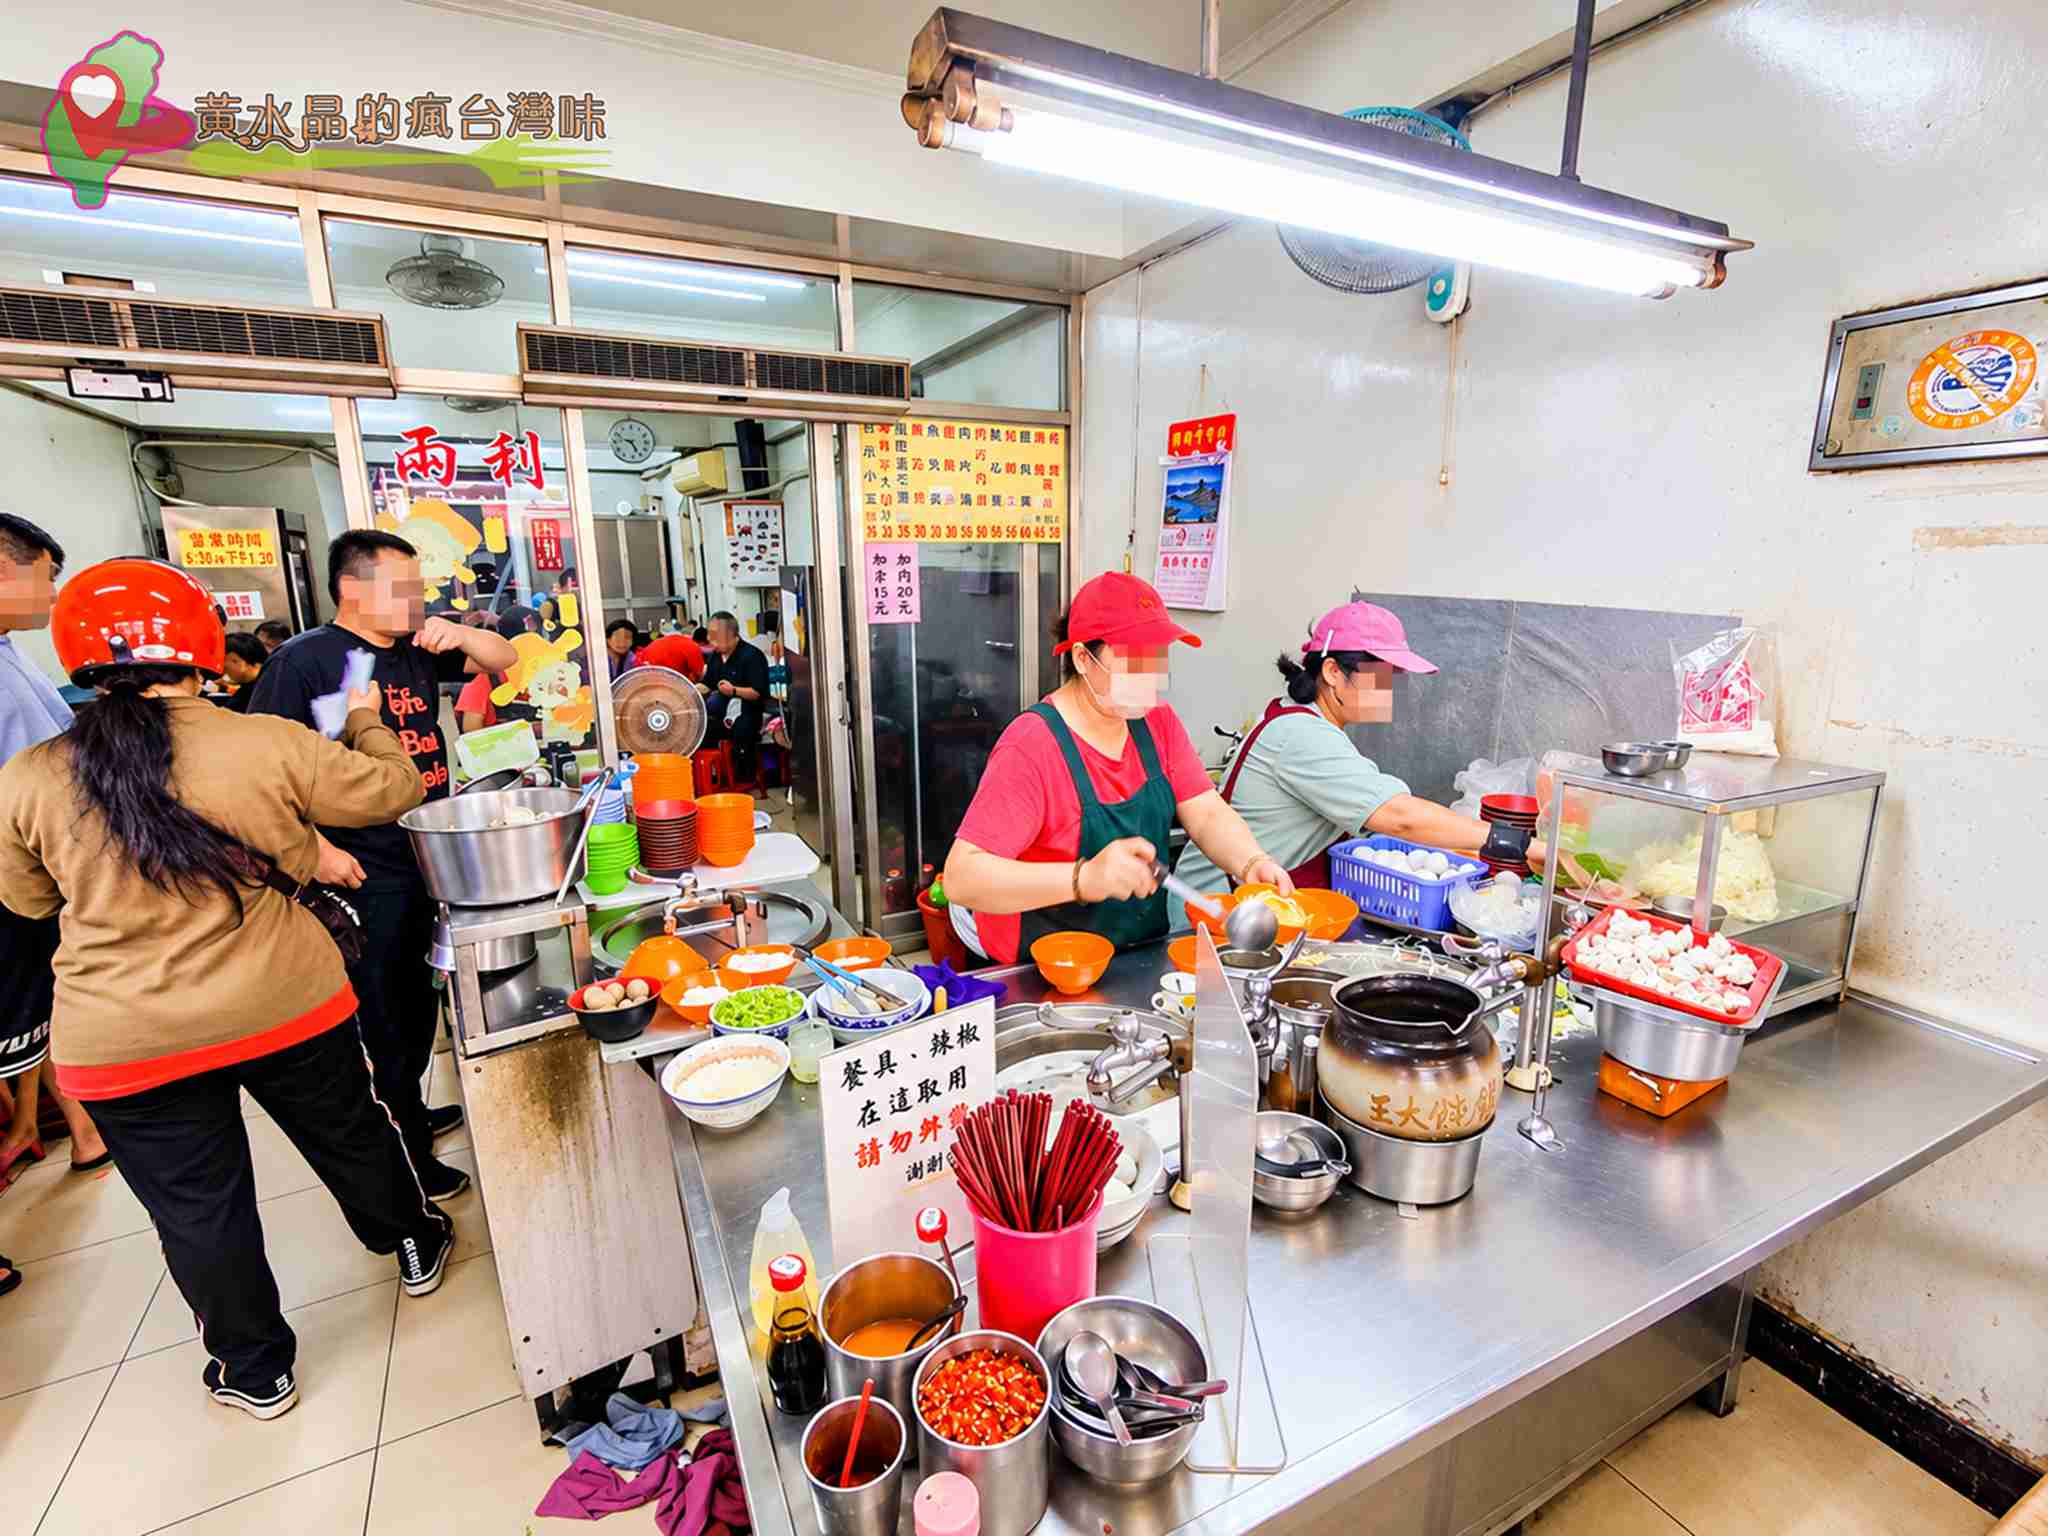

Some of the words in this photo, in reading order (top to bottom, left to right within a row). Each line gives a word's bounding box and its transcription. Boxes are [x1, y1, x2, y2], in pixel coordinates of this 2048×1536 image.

[394, 425, 544, 491] 兩利
[841, 1022, 981, 1092] 餐具、辣椒
[857, 1065, 968, 1128] 在這取用
[906, 1151, 956, 1182] 謝謝
